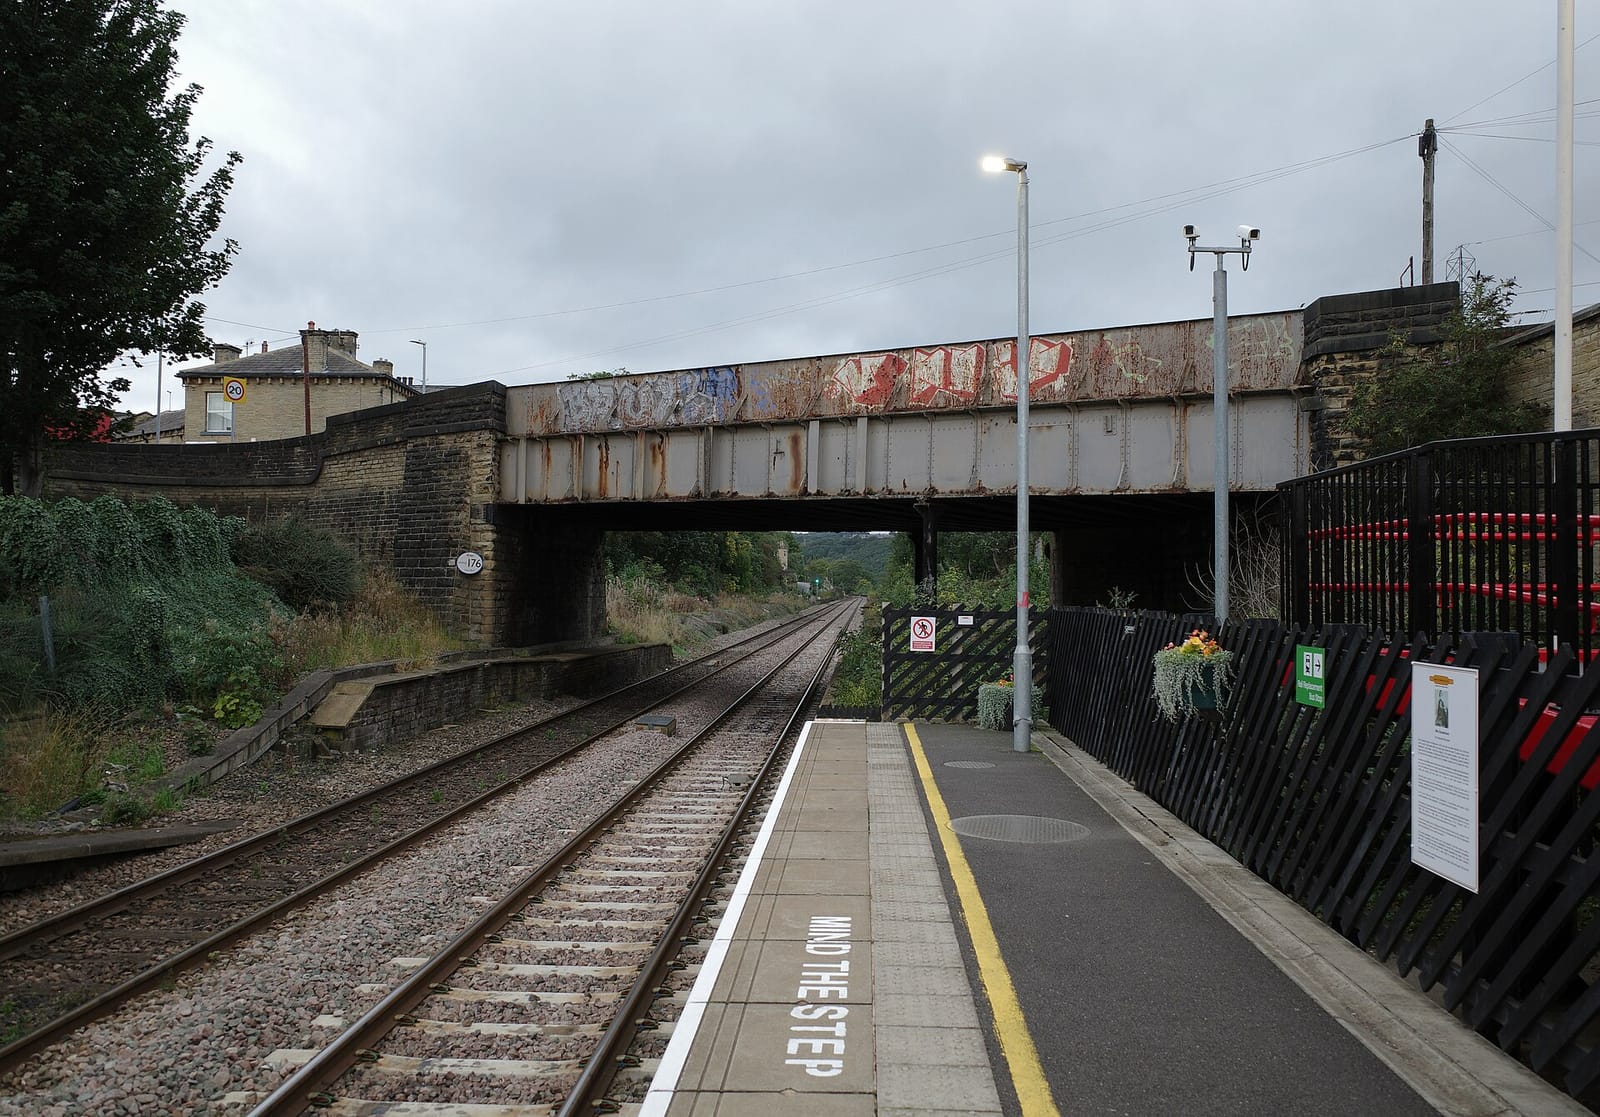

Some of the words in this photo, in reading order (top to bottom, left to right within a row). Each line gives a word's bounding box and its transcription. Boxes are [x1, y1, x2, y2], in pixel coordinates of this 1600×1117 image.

[229, 385, 242, 395] 20
[467, 558, 482, 568] 176
[805, 916, 852, 956] MIND
[797, 960, 850, 999] THE
[784, 1004, 849, 1077] STEP
